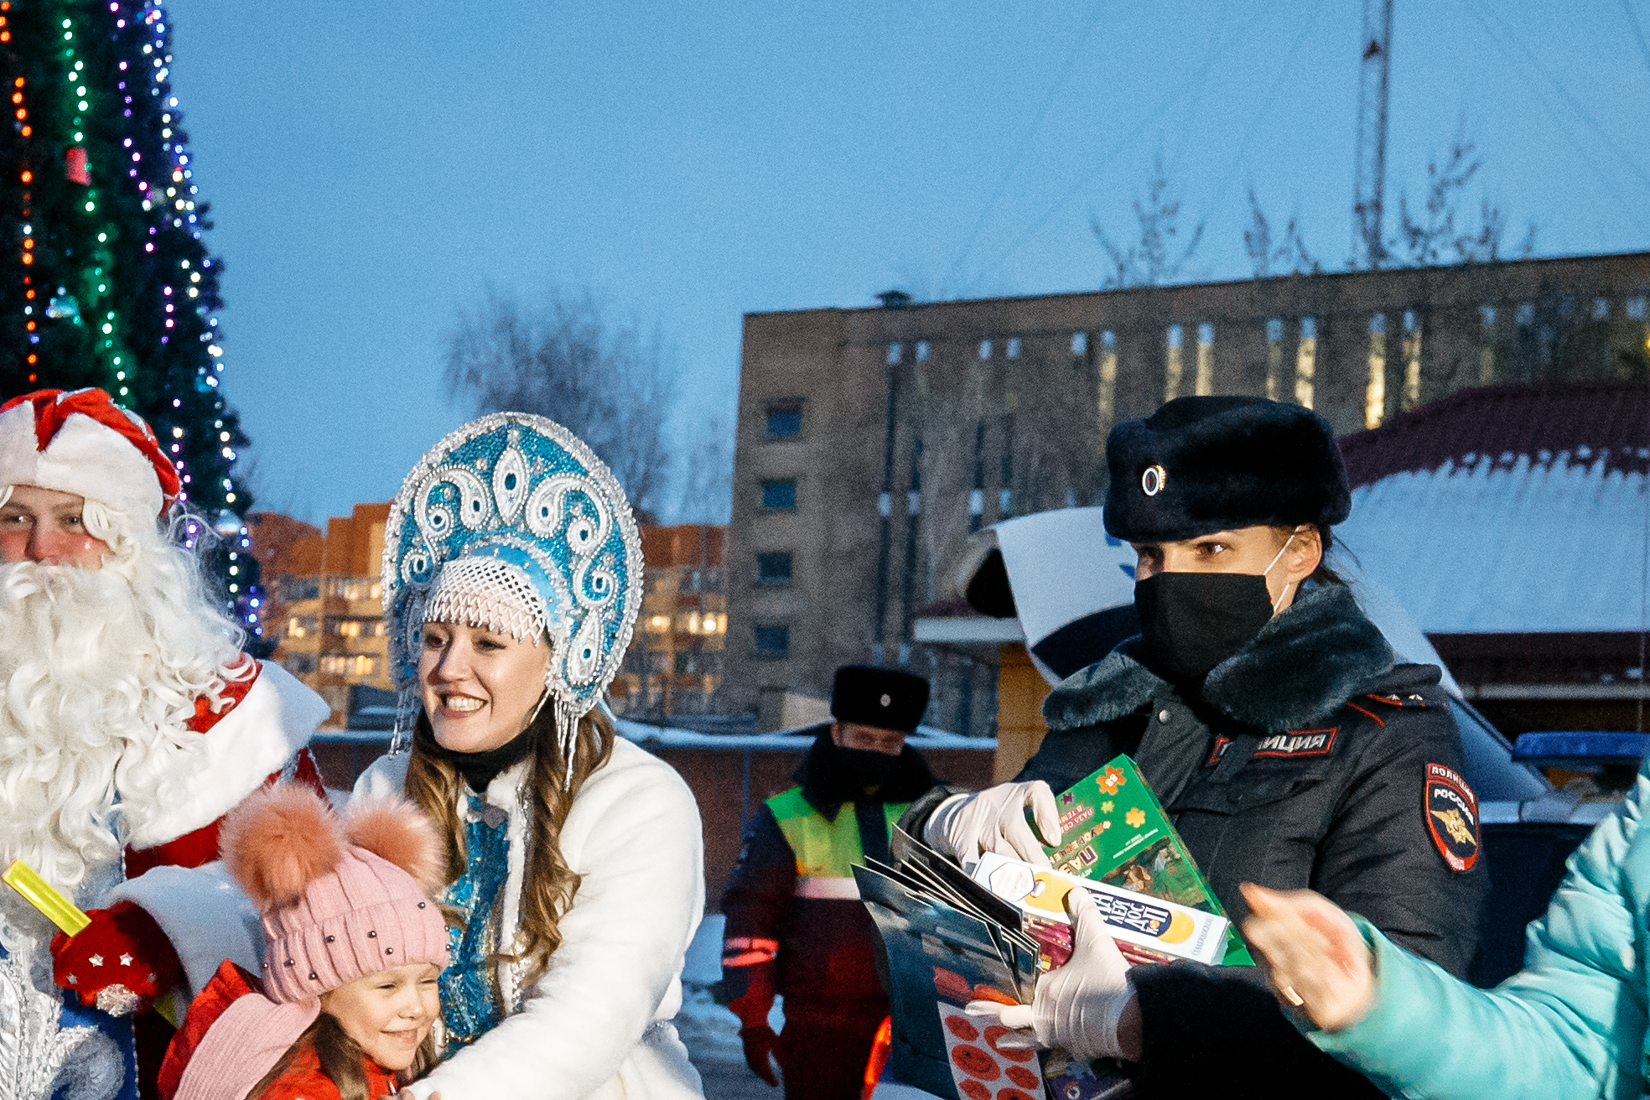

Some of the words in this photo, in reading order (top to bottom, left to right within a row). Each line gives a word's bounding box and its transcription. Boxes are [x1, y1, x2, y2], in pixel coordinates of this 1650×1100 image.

[1105, 773, 1118, 787] 88
[1431, 765, 1475, 804] ПОЛИЦИЯ
[1433, 788, 1475, 826] РОССИЯ
[1057, 845, 1098, 875] ПАЗ
